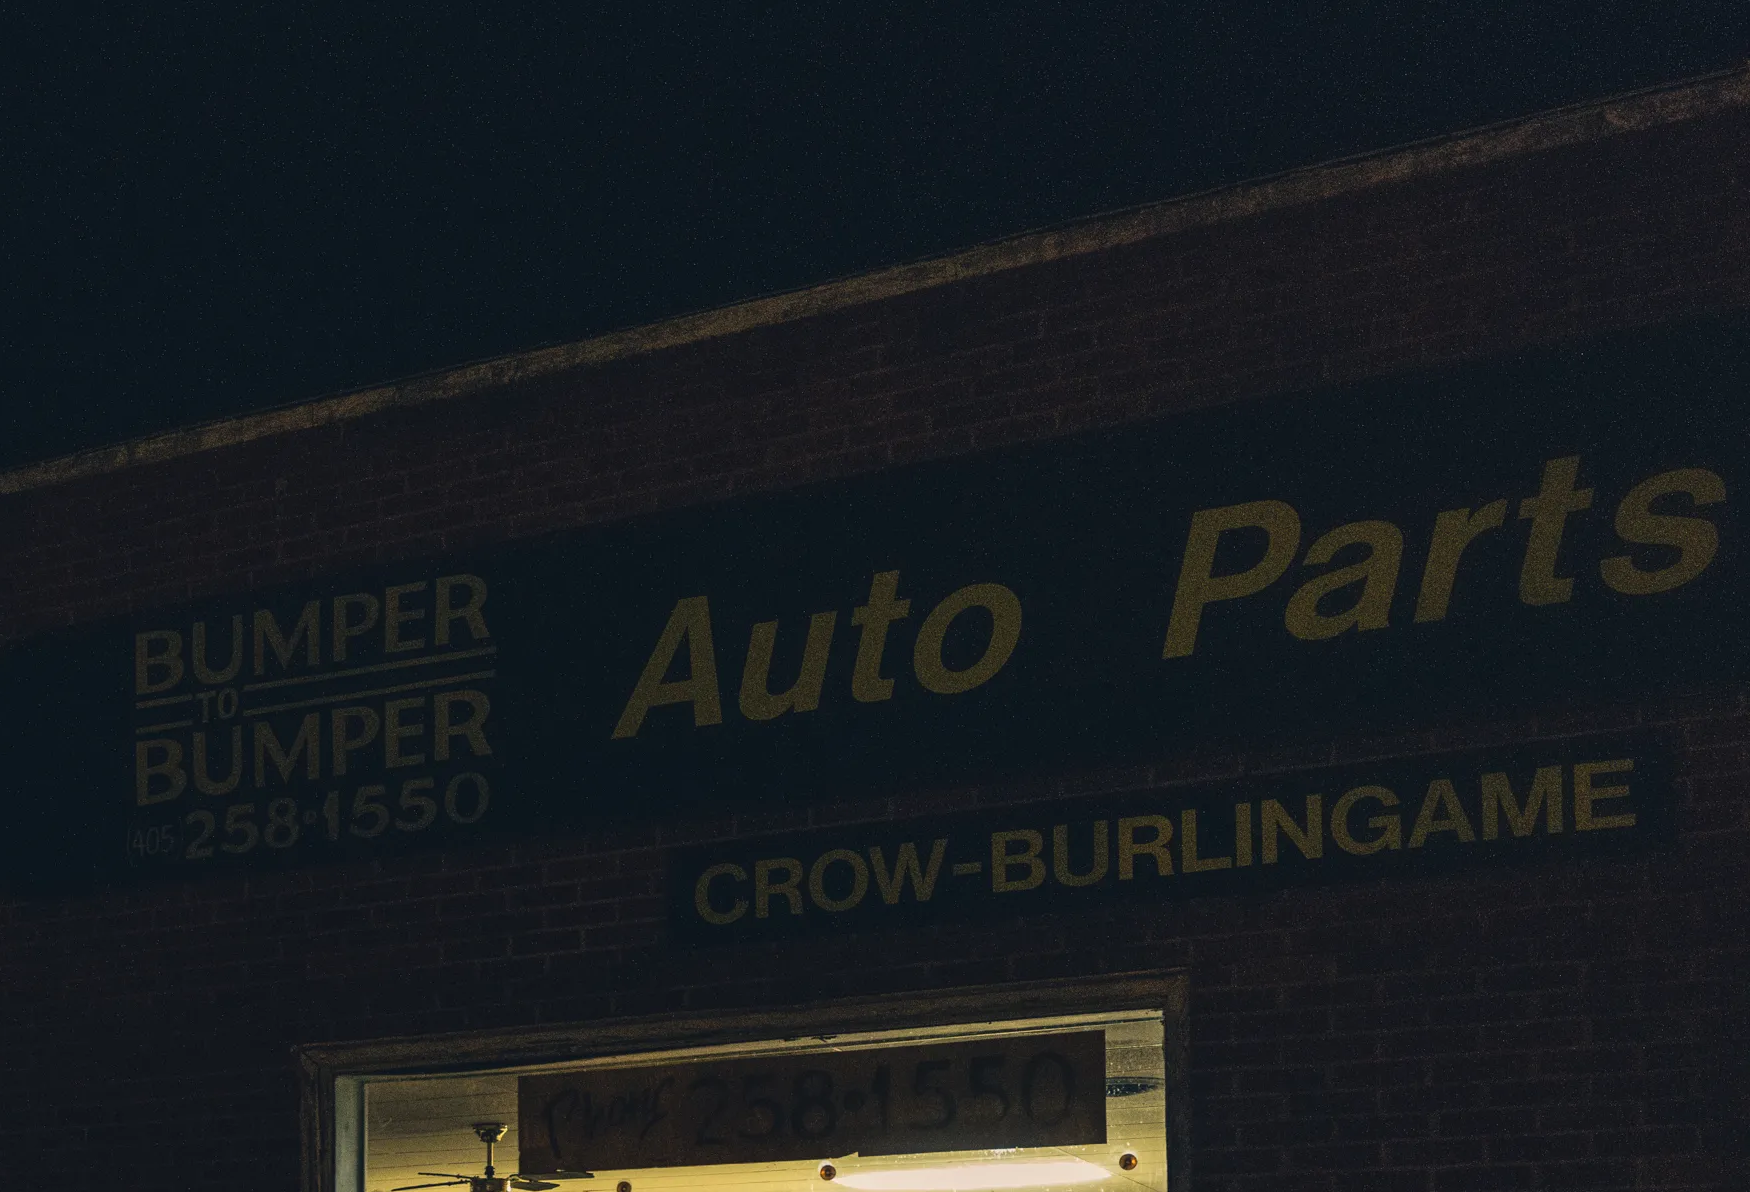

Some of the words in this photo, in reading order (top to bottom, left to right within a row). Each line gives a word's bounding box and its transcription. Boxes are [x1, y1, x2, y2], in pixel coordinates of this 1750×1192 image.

[135, 573, 491, 696] BUMPER
[611, 569, 1023, 739] Auto
[1161, 454, 1728, 660] Parts
[135, 689, 493, 806] BUMPER
[198, 688, 239, 723] TO
[694, 758, 1638, 924] CROW-BURLINGAME
